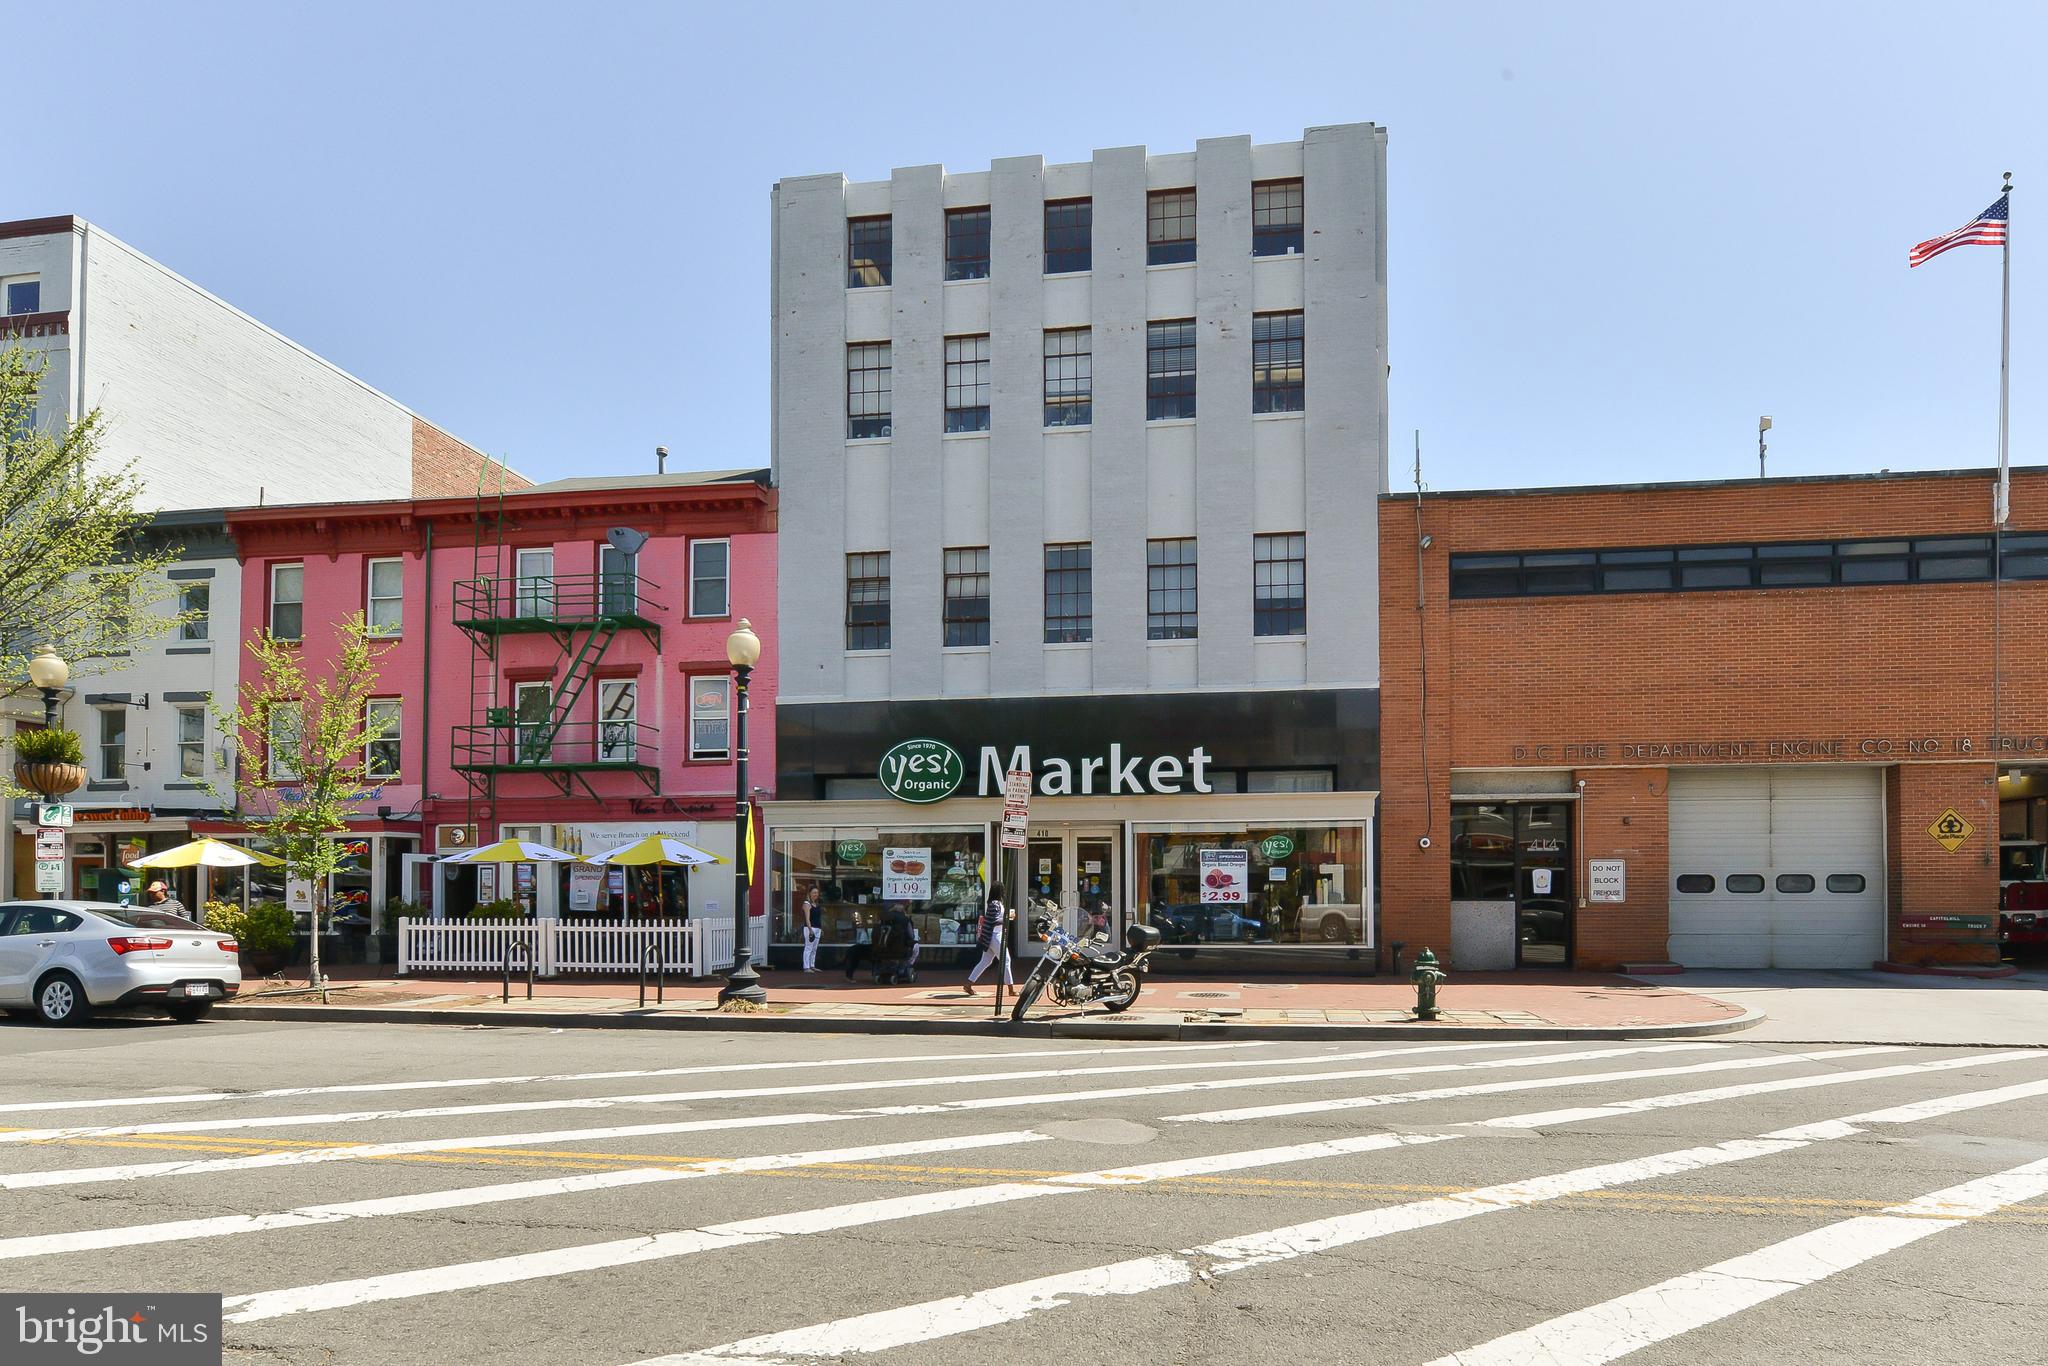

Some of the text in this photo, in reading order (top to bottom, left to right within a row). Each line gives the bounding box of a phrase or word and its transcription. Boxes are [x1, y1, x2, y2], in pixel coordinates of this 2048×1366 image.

[1513, 745, 1527, 760] D
[1536, 744, 1549, 759] C
[1565, 743, 1609, 759] FIRE
[1623, 741, 1751, 758] DEPARTMENT
[1769, 740, 1844, 756] ENGINE
[1861, 739, 1892, 754] CO
[1909, 739, 1938, 753] NO
[1955, 738, 1972, 752] 18
[888, 750, 952, 792] yes!
[978, 743, 1212, 796] Market
[904, 779, 951, 792] Organic
[1265, 839, 1289, 856] yes!
[1530, 838, 1557, 849] 414
[122, 850, 140, 862] food
[574, 865, 603, 873] GRAND
